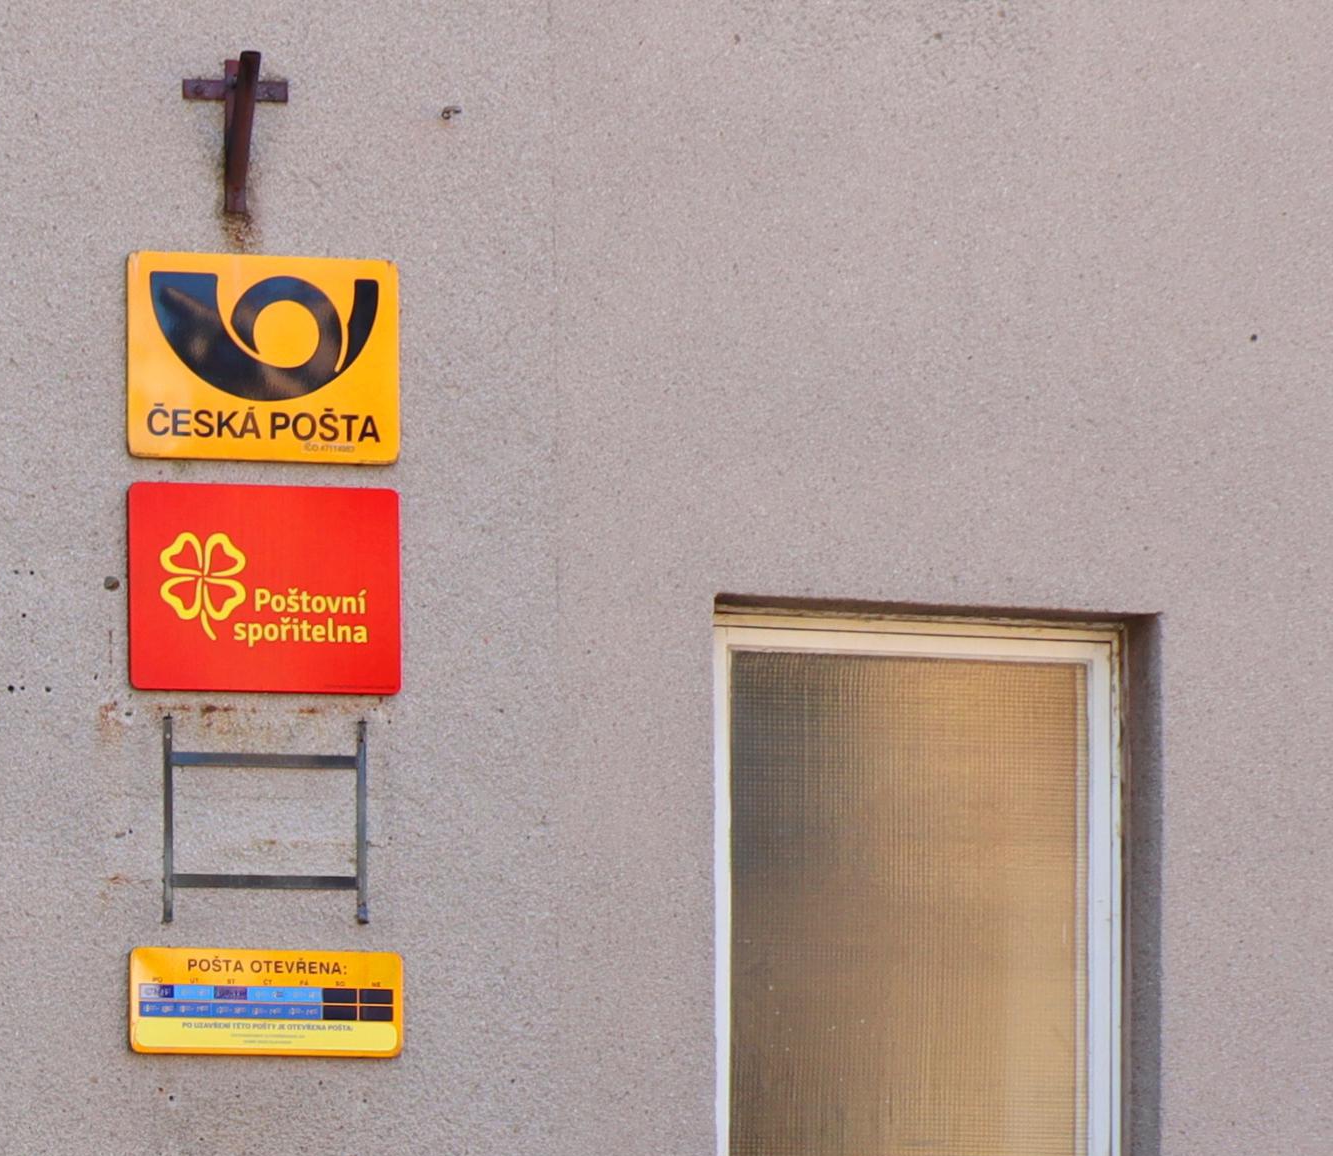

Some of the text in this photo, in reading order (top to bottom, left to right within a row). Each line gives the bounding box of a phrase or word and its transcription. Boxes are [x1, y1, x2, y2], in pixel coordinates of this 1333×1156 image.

[147, 403, 381, 443] ČESKÁ POŠTA
[254, 588, 367, 614] Poštovní
[233, 617, 368, 647] spořitelna
[187, 956, 347, 975] POŠTA OTEVŘENA:
